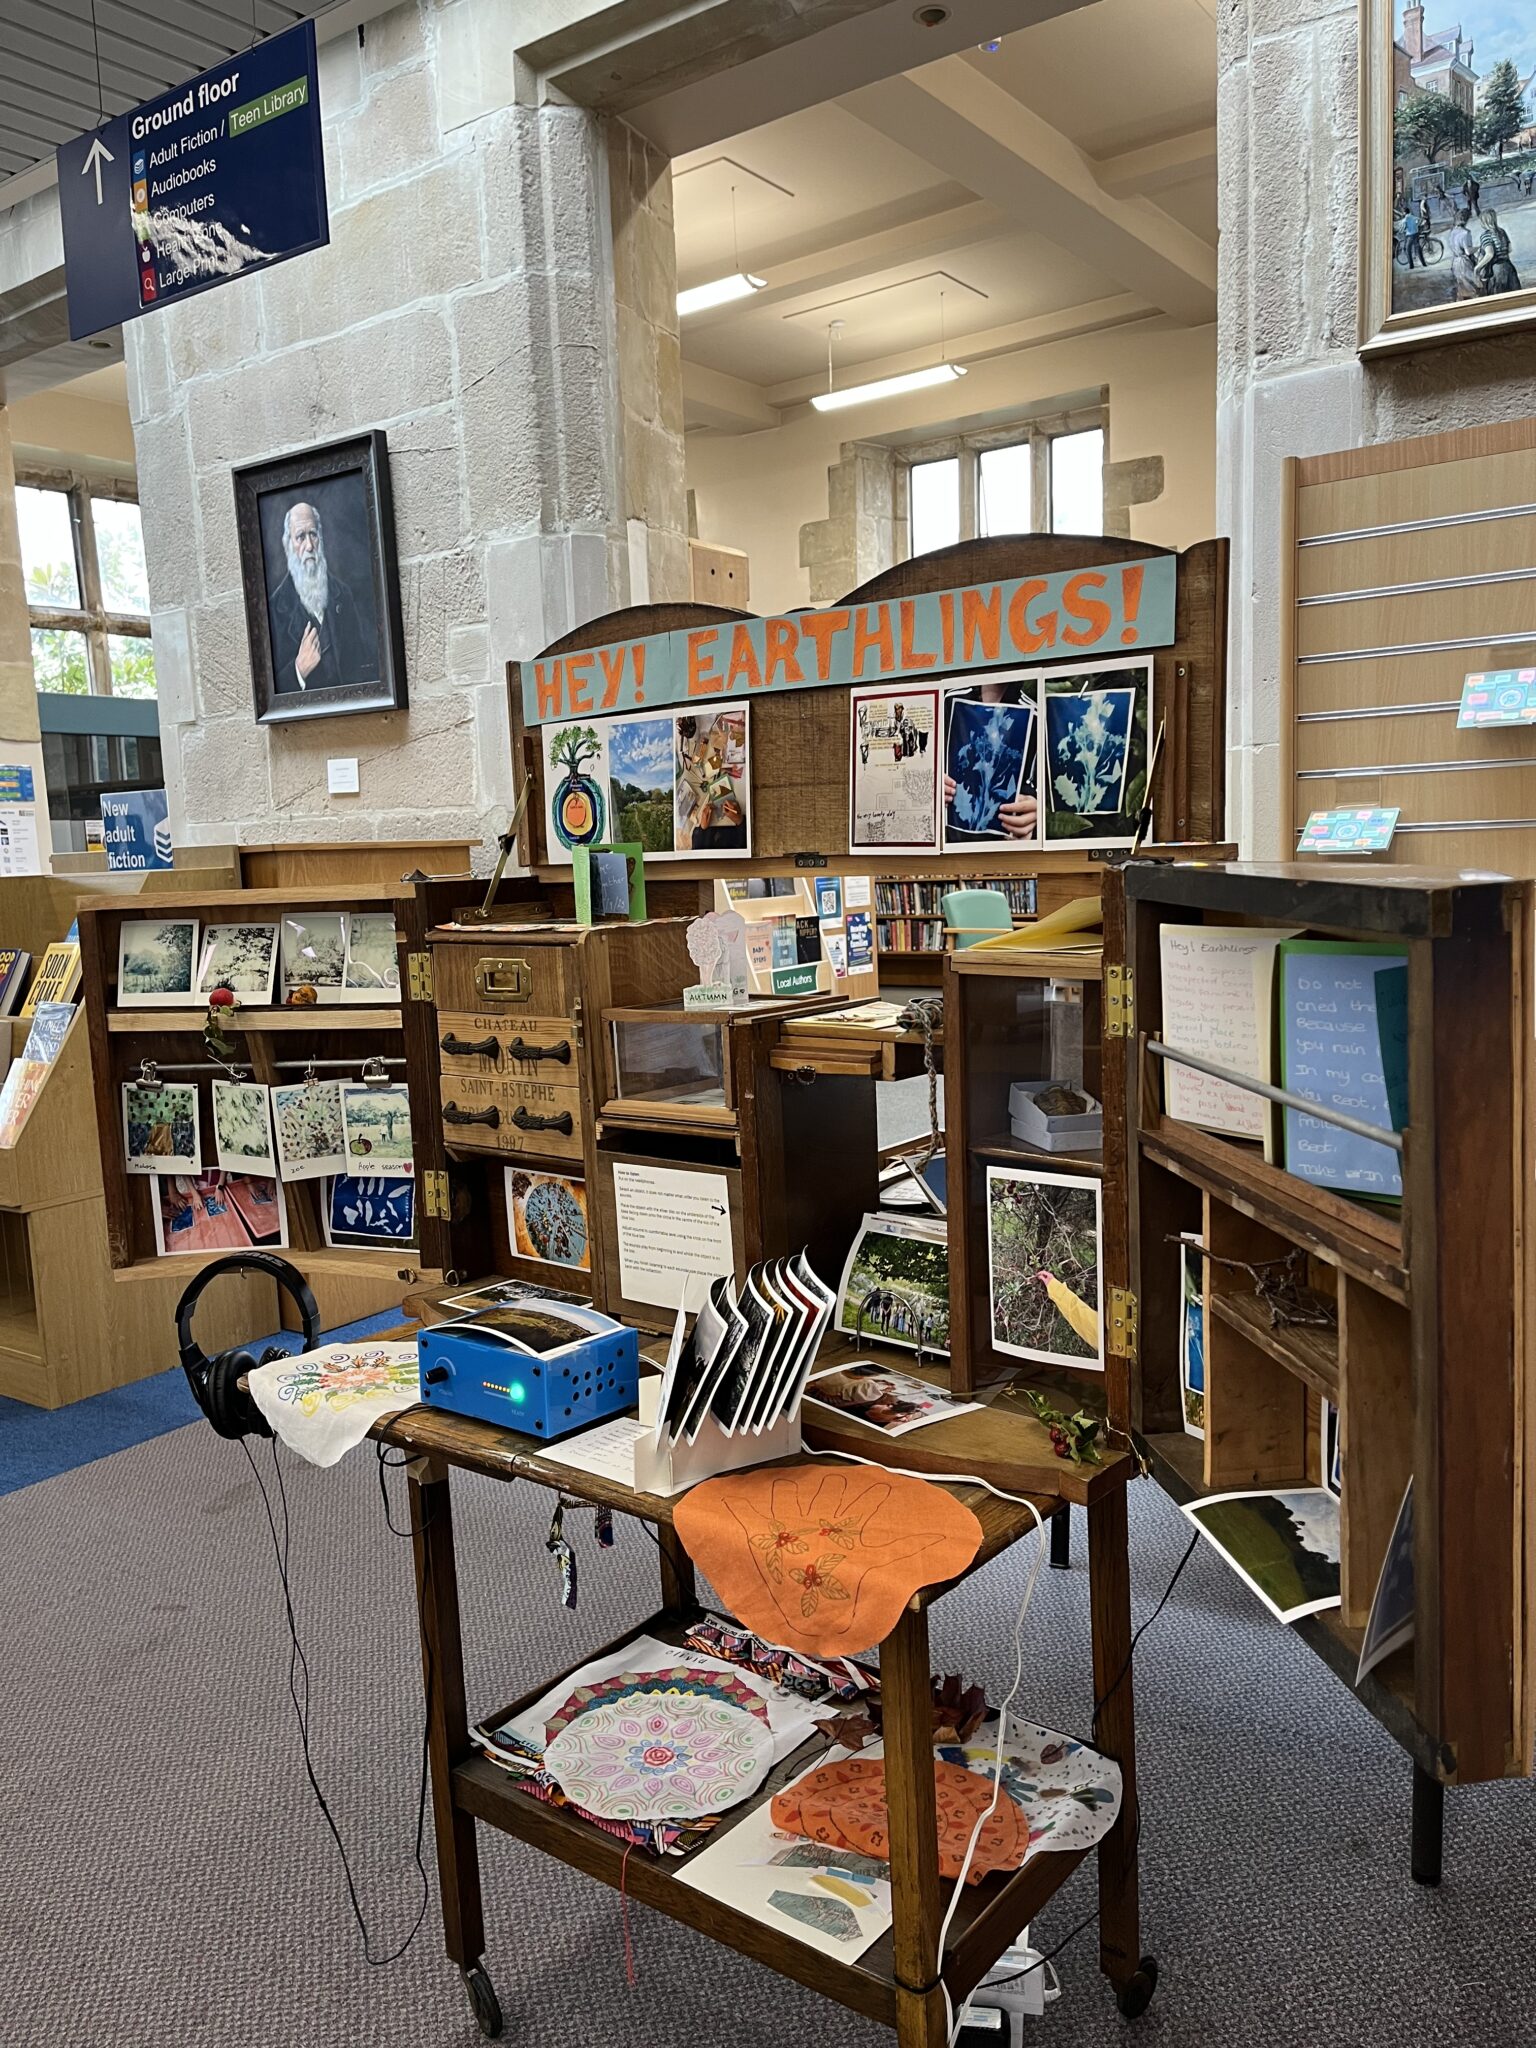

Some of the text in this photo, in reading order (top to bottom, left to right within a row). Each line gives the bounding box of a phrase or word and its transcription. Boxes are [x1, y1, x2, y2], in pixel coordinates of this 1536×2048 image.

[131, 71, 241, 141] Ground floor
[149, 84, 306, 169] Adult Fiction / Teen Library
[150, 157, 217, 198] Audiobooks
[153, 192, 215, 229] Computers
[159, 264, 190, 289] Large
[534, 562, 1145, 719] HEY! EARTHLINGS!
[103, 800, 129, 817] New
[106, 826, 136, 844] adult
[108, 852, 146, 870] fiction
[752, 946, 765, 954] BABY
[1170, 939, 1257, 956] Hey! Earthlings
[40, 953, 72, 979] SOON
[777, 975, 812, 989] Local Authors
[1299, 978, 1362, 991] Do not
[690, 993, 727, 1002] AUTUMN
[474, 1017, 537, 1032] CHATEAU
[1326, 1069, 1351, 1087] my
[382, 1163, 403, 1171] season
